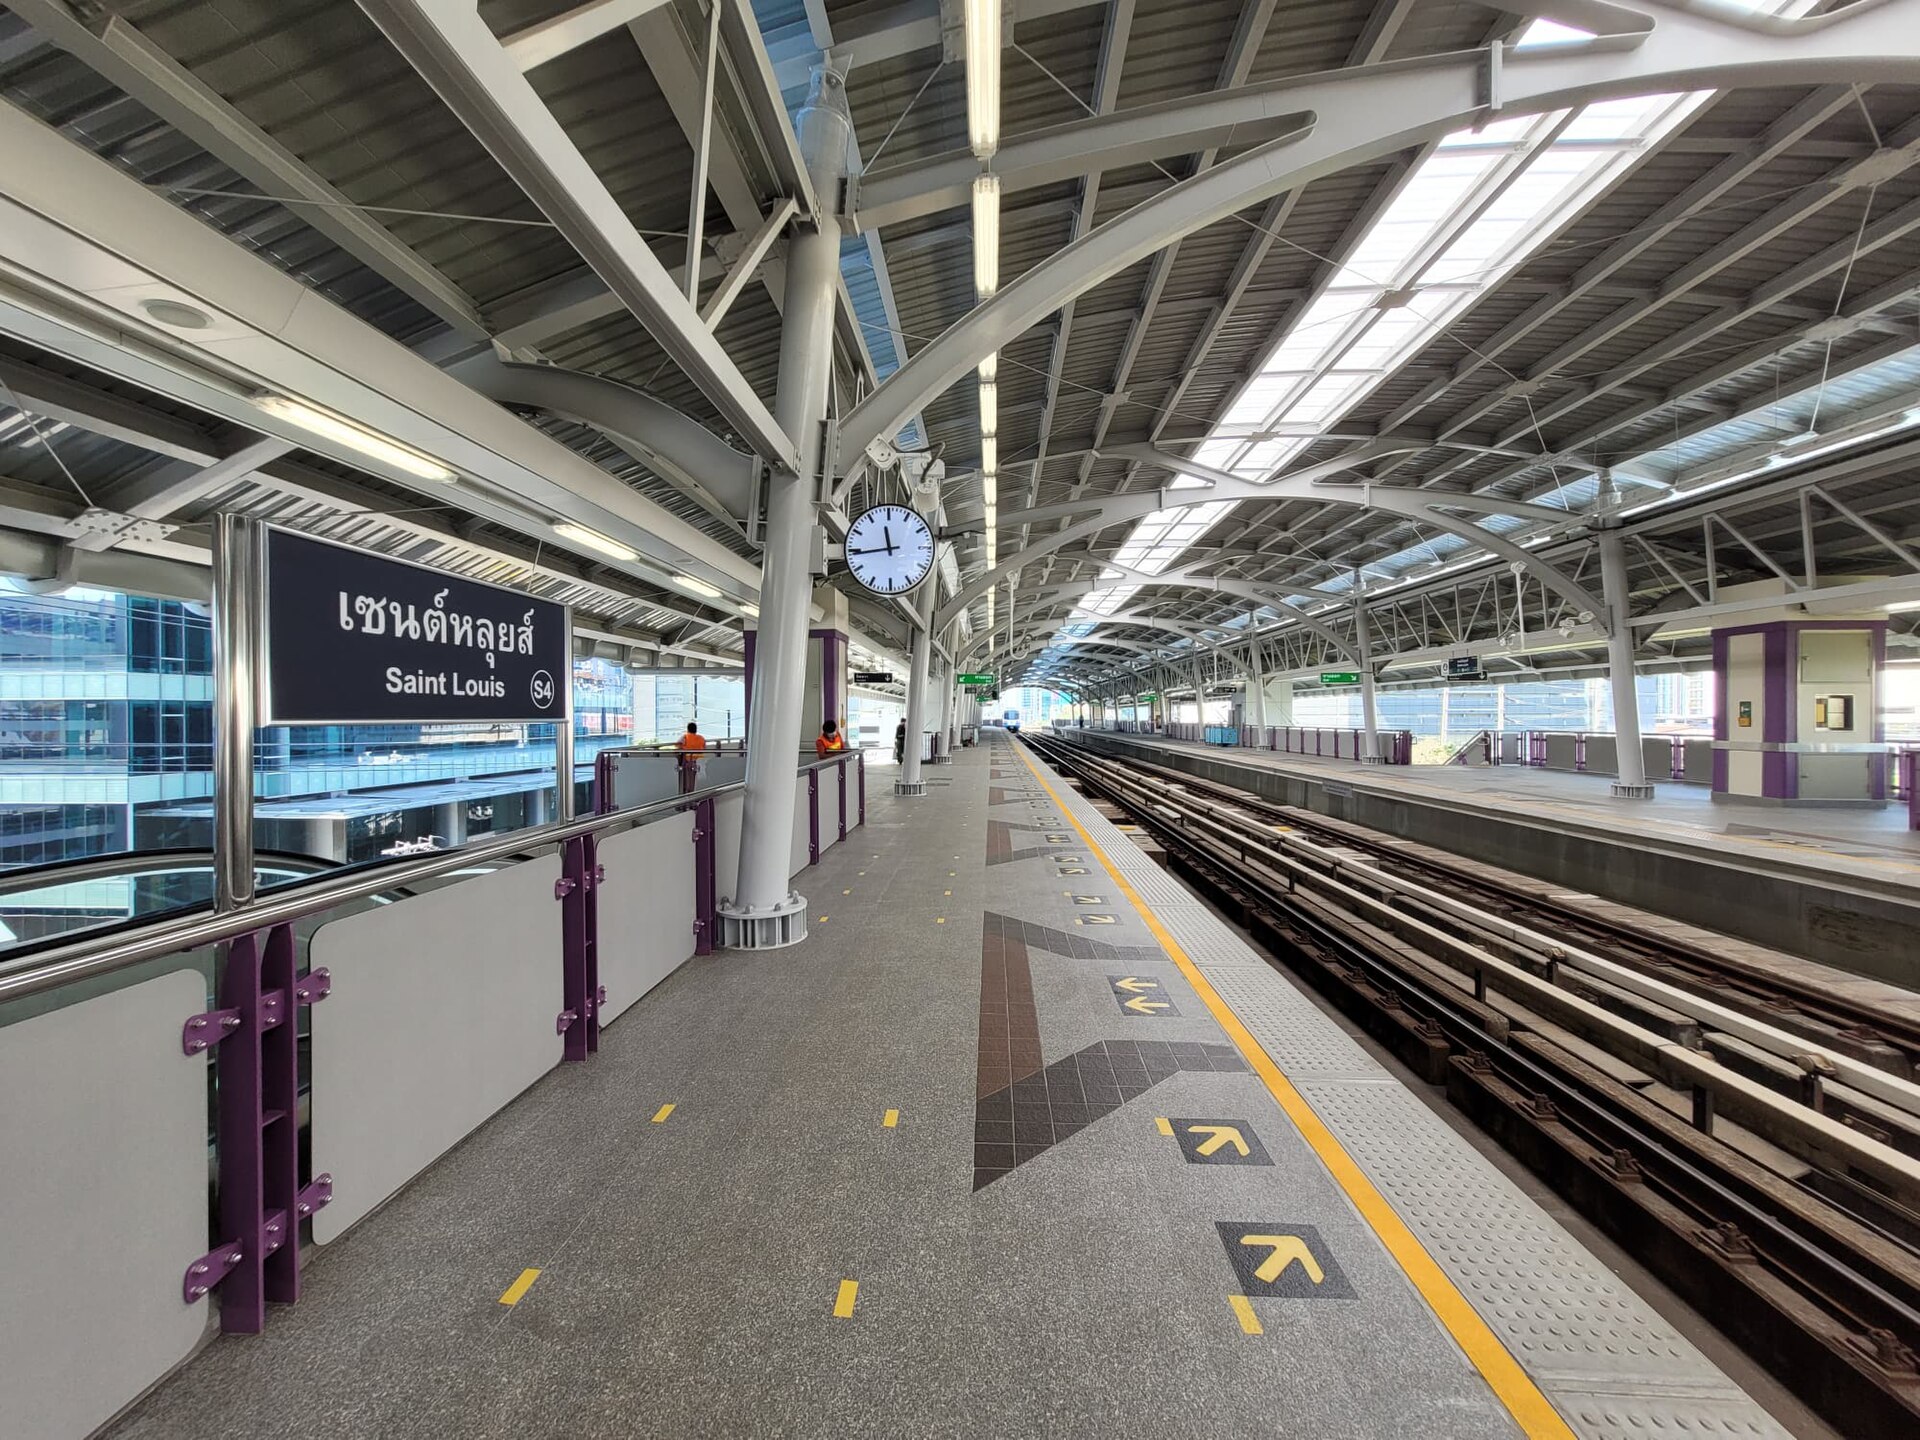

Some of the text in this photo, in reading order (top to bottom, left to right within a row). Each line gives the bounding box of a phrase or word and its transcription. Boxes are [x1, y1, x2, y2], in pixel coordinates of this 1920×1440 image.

[339, 588, 535, 668] เซนต์หลุยส์
[385, 667, 506, 698] Saint Louis
[533, 680, 552, 699] S4
